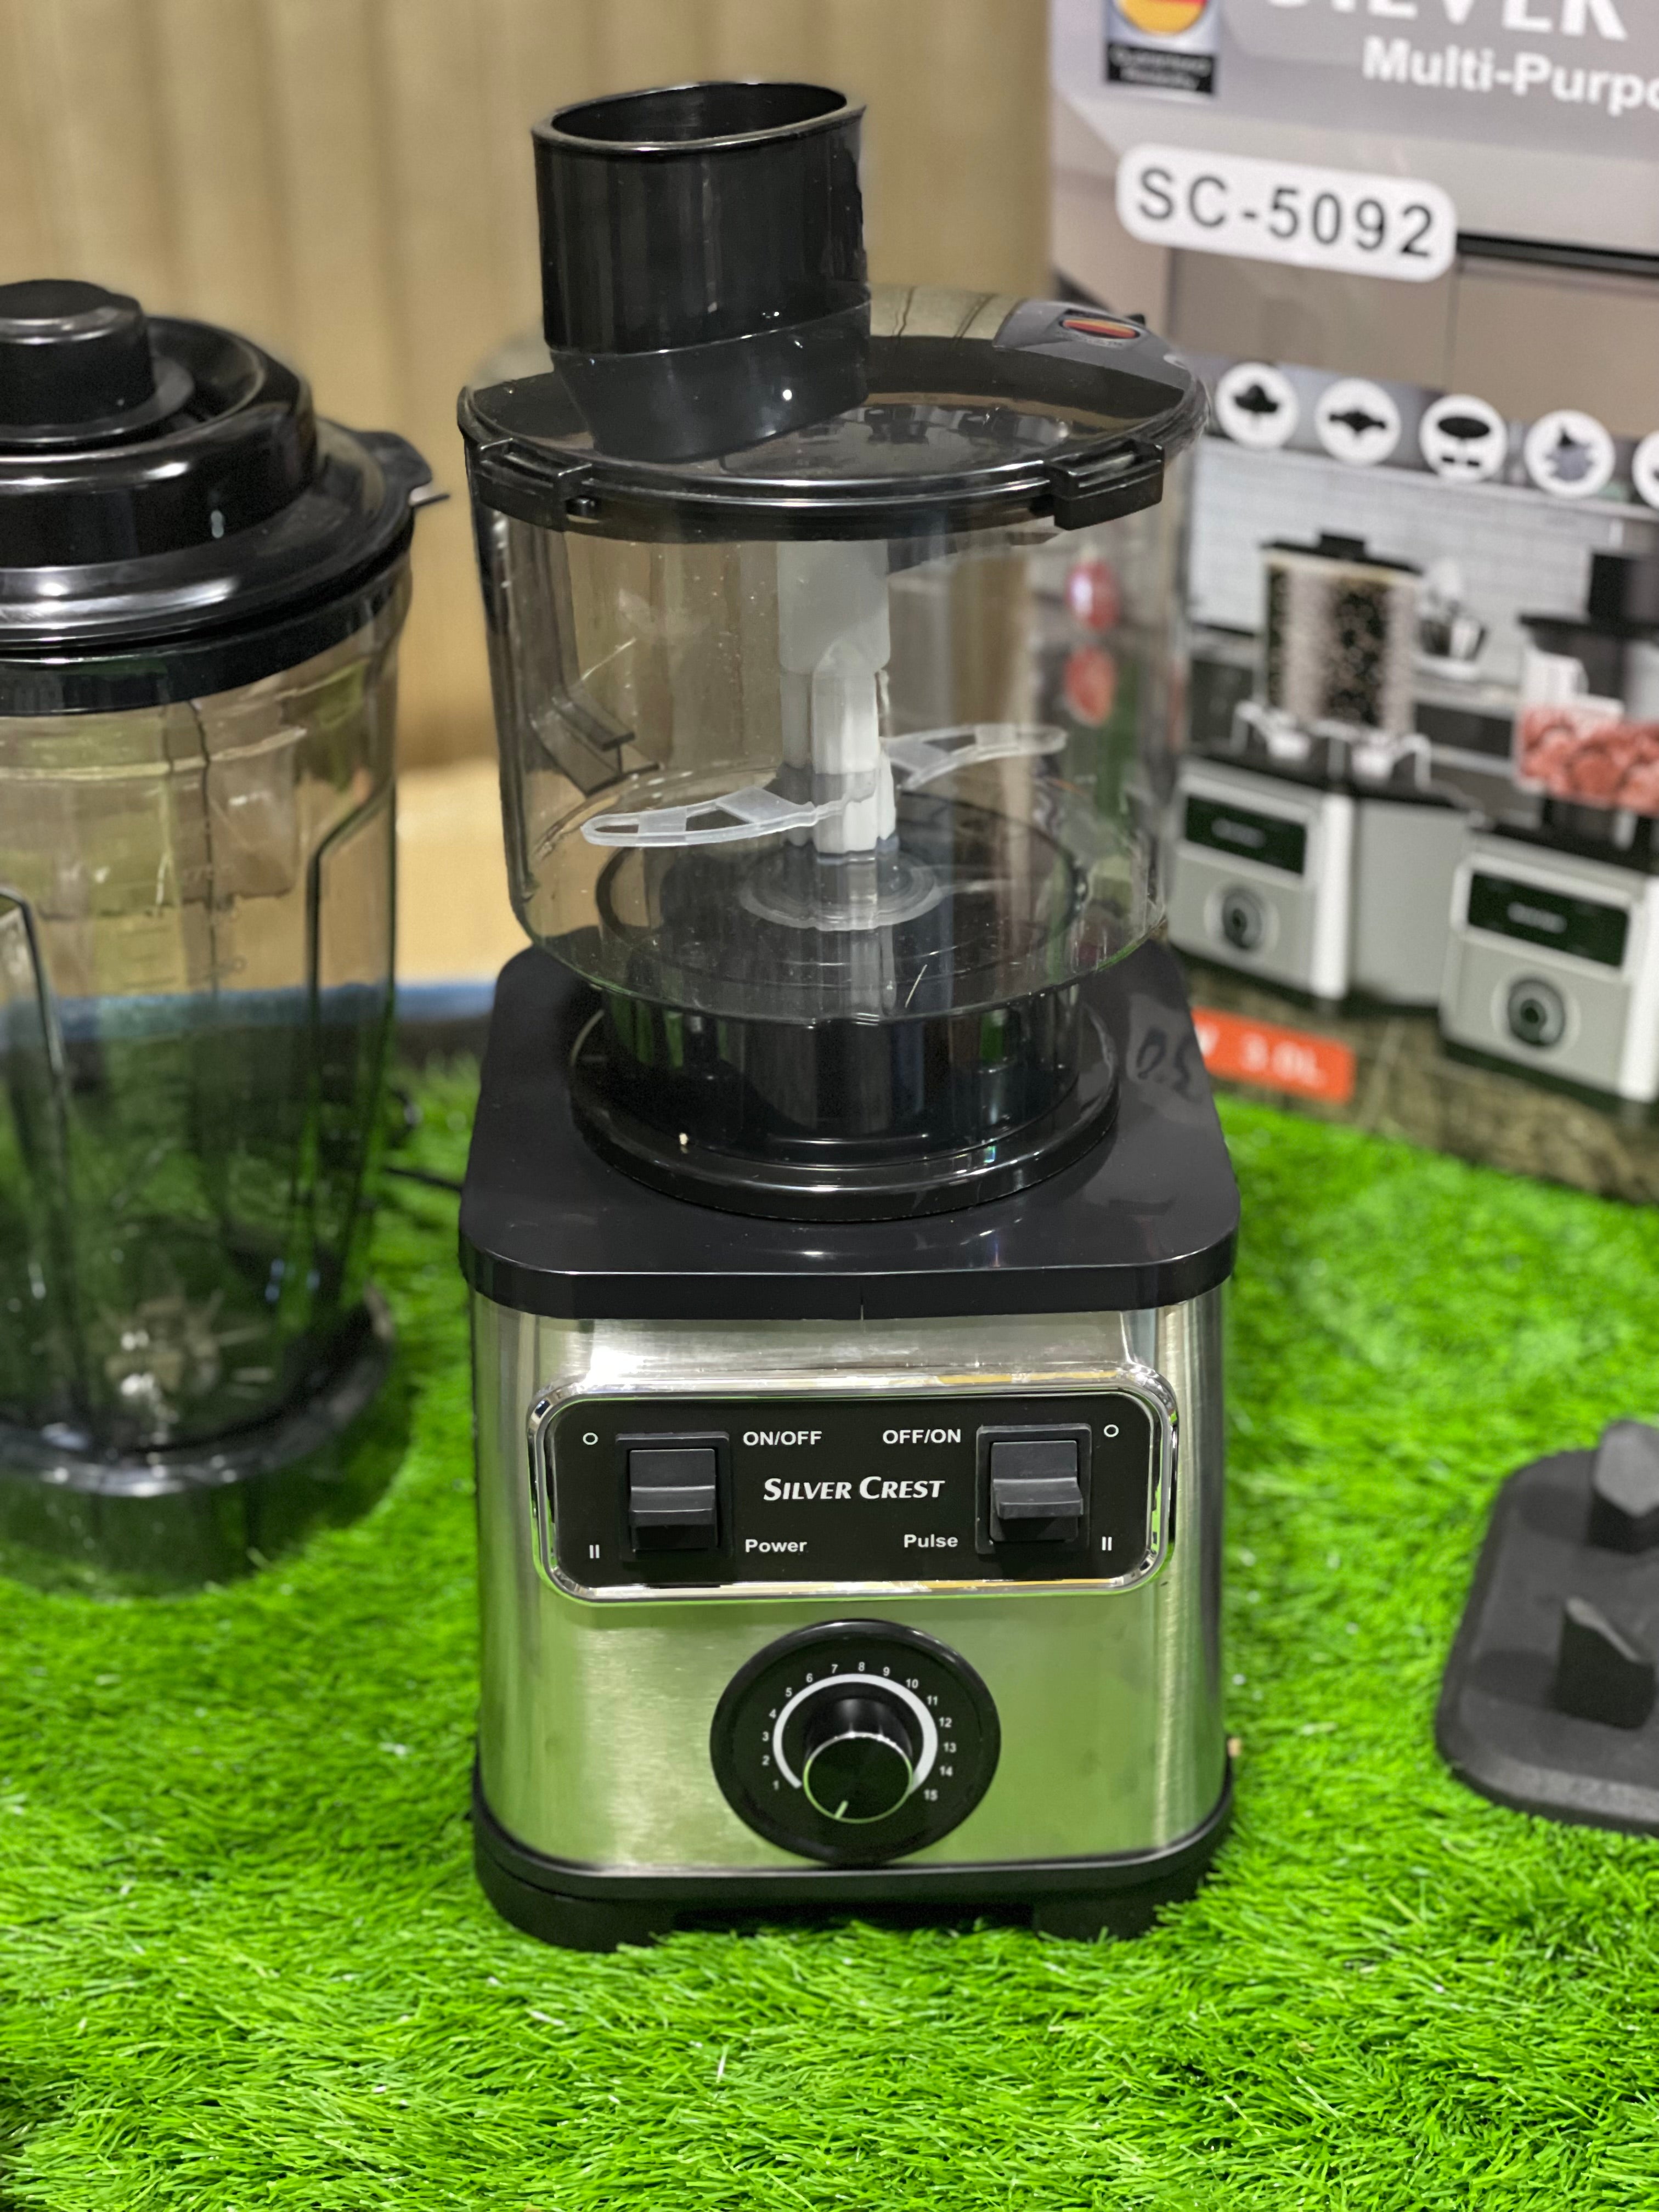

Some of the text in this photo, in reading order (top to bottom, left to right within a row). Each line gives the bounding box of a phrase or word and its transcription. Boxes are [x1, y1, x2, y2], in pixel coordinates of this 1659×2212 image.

[1138, 167, 1434, 258] SC-5092
[742, 1430, 823, 1447] ON/OFF
[882, 1428, 962, 1445] OFF/ON
[763, 1475, 946, 1502] SILVER CREST
[744, 1538, 808, 1553] Power
[903, 1533, 959, 1549] Pulse
[761, 1661, 957, 1802] 1 2 3 4 5 6 7 8 9 10 11 12 13 14 15
